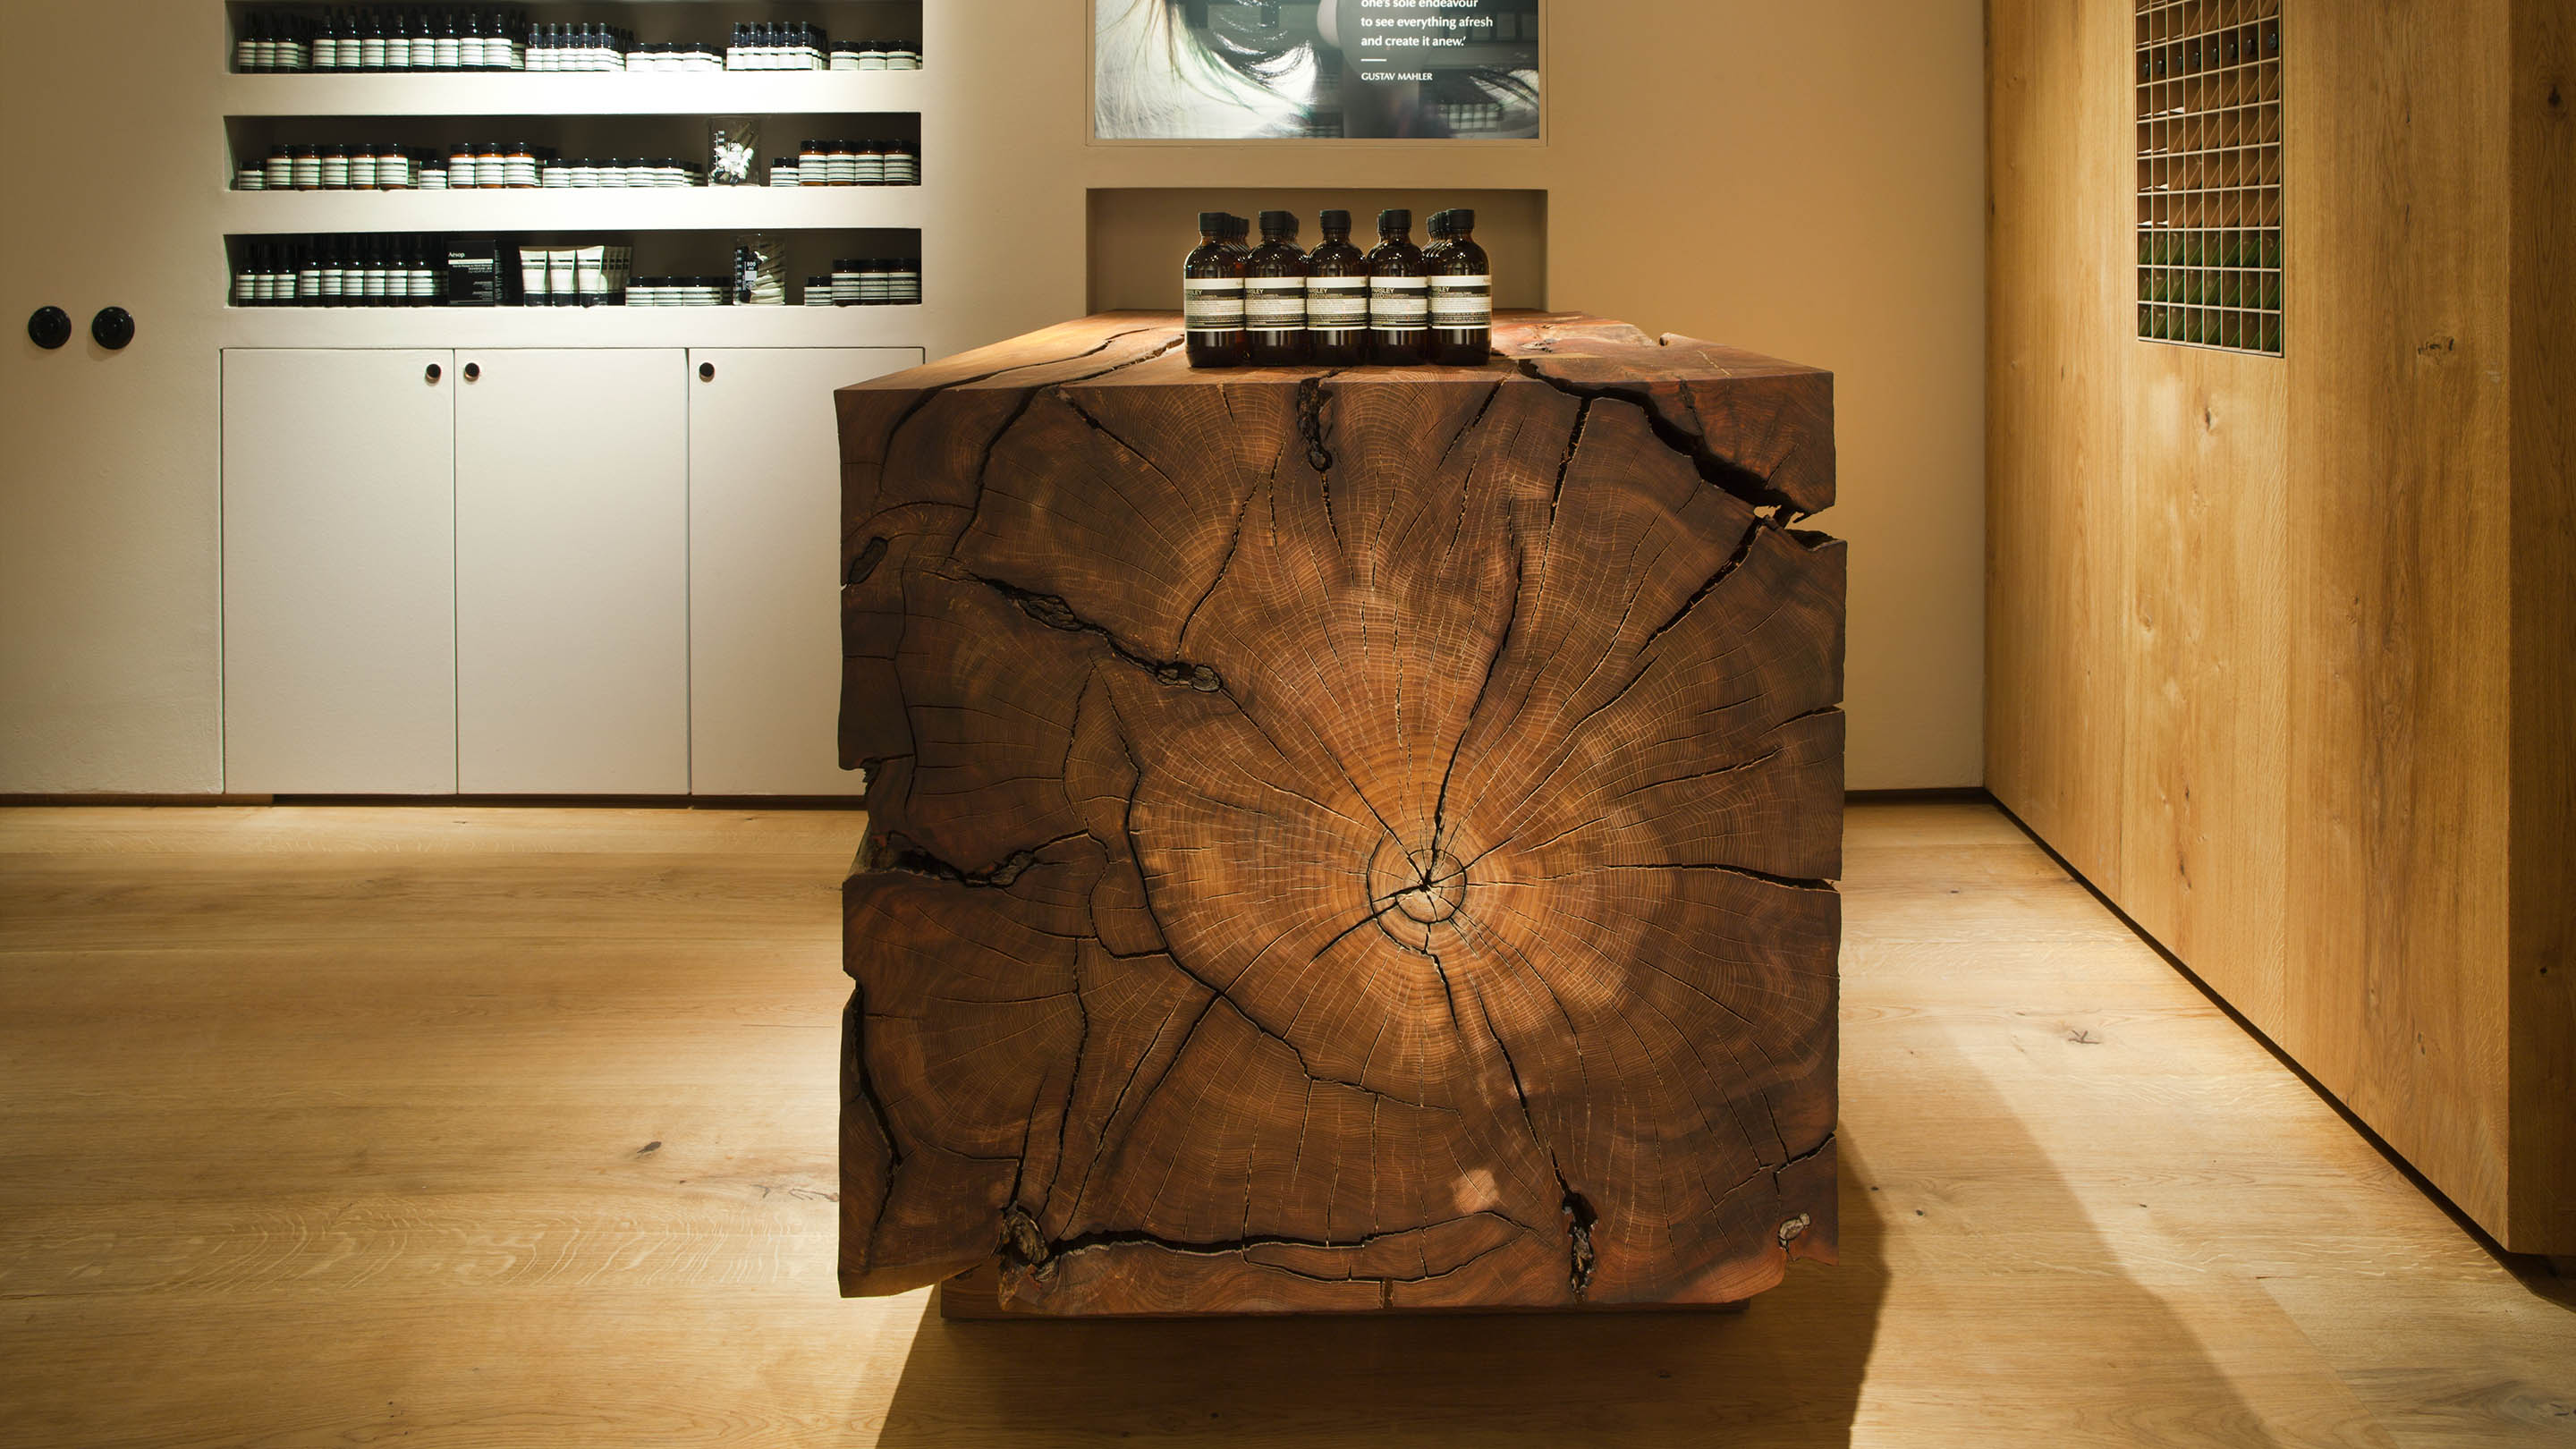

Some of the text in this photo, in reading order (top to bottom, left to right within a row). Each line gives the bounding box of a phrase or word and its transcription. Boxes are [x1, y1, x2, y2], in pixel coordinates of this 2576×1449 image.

[1393, 0, 1416, 8] sole
[1419, 0, 1479, 8] endeavour
[1360, 16, 1494, 30] to see everything afresh
[1360, 36, 1383, 47] and
[1385, 37, 1419, 47] create
[1422, 36, 1430, 47] it
[1360, 72, 1433, 80] GUSTAV MAHLER
